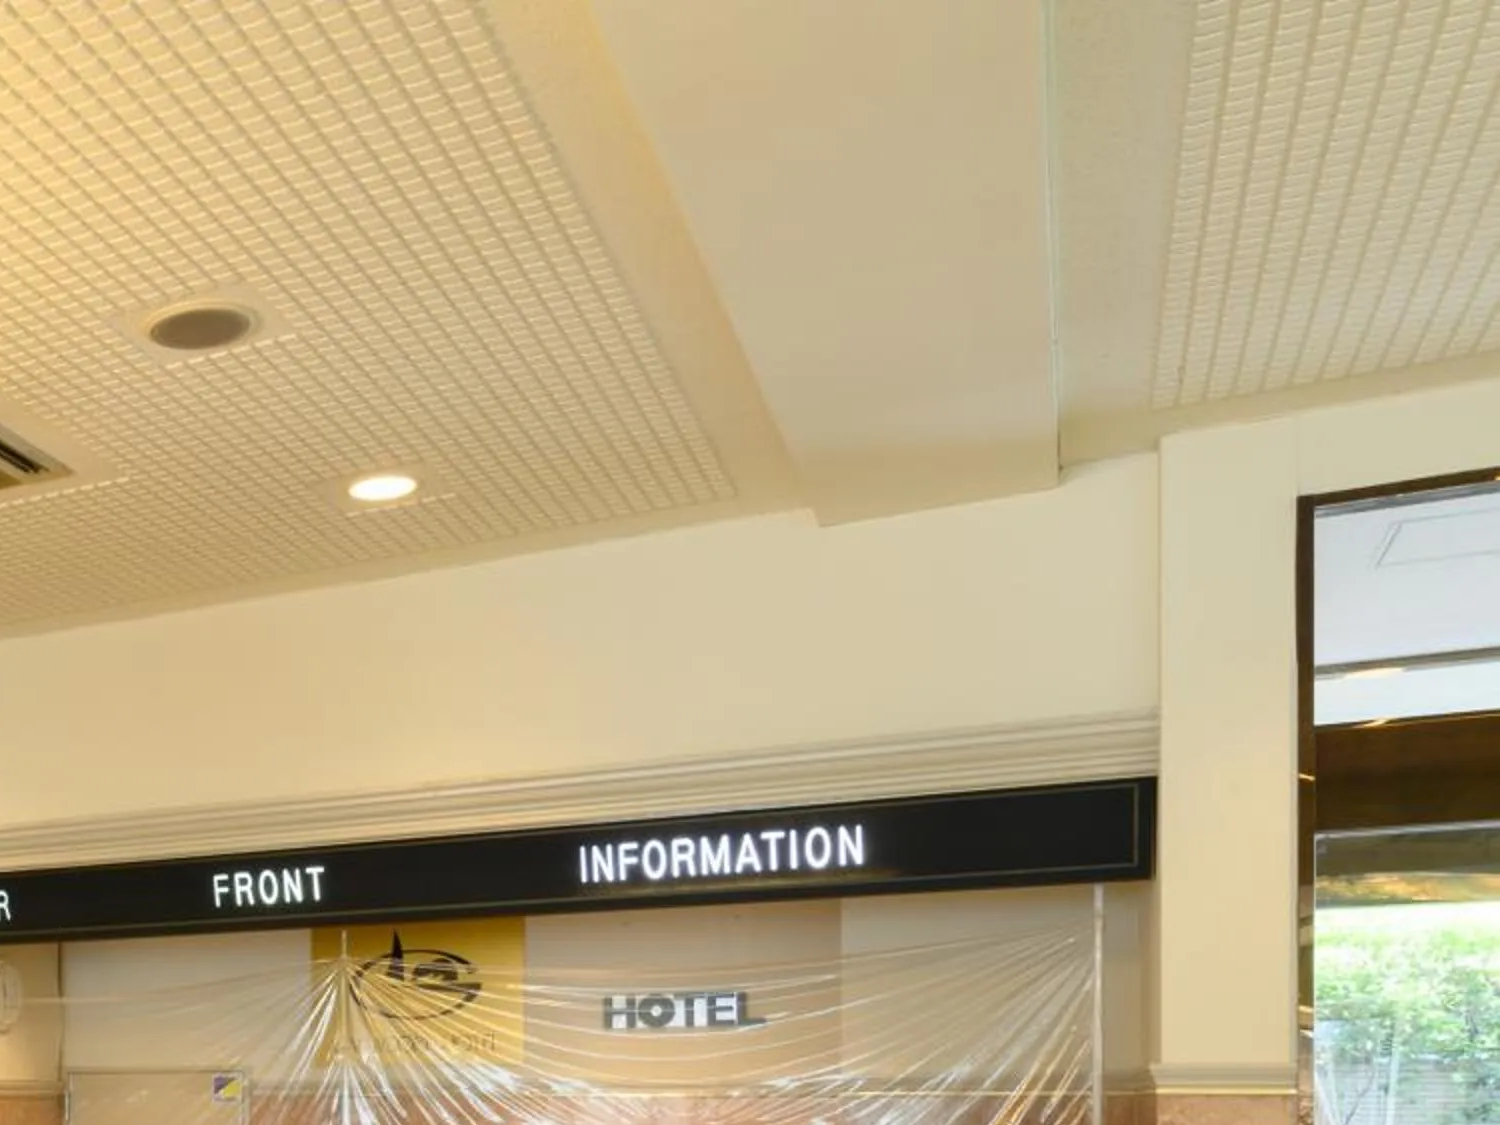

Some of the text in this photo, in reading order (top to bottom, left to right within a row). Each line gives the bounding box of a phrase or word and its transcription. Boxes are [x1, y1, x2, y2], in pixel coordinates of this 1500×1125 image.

[579, 825, 865, 884] INFORMATION
[212, 866, 326, 907] FRONT
[604, 992, 767, 1030] HOTEL
